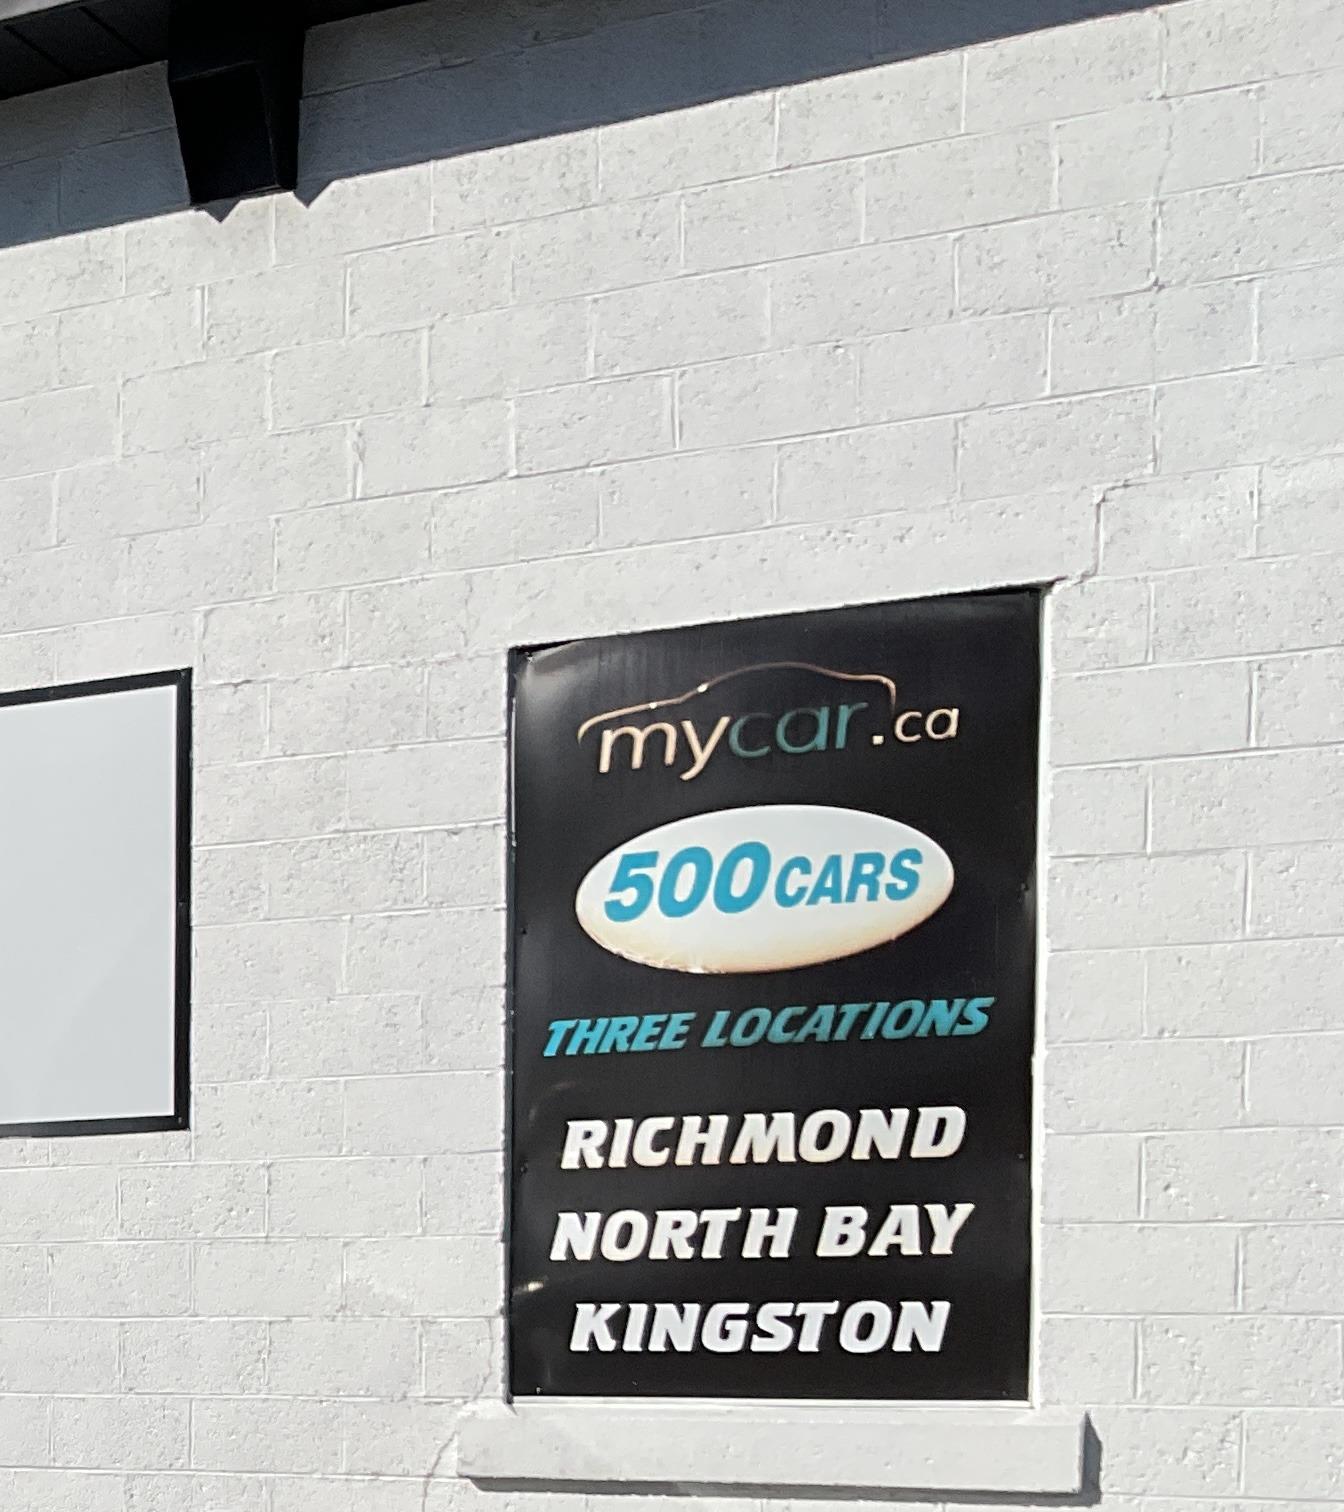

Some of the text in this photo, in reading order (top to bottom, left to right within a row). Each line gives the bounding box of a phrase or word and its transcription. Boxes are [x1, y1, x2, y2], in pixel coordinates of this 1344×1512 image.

[598, 701, 960, 781] mycar.ca
[603, 841, 924, 923] 500 CARS
[542, 996, 997, 1058] THREE LOCATIONS
[559, 1105, 968, 1171] RICHMOND
[548, 1202, 976, 1263] NORTH BAY
[568, 1299, 952, 1355] KINGSTON
